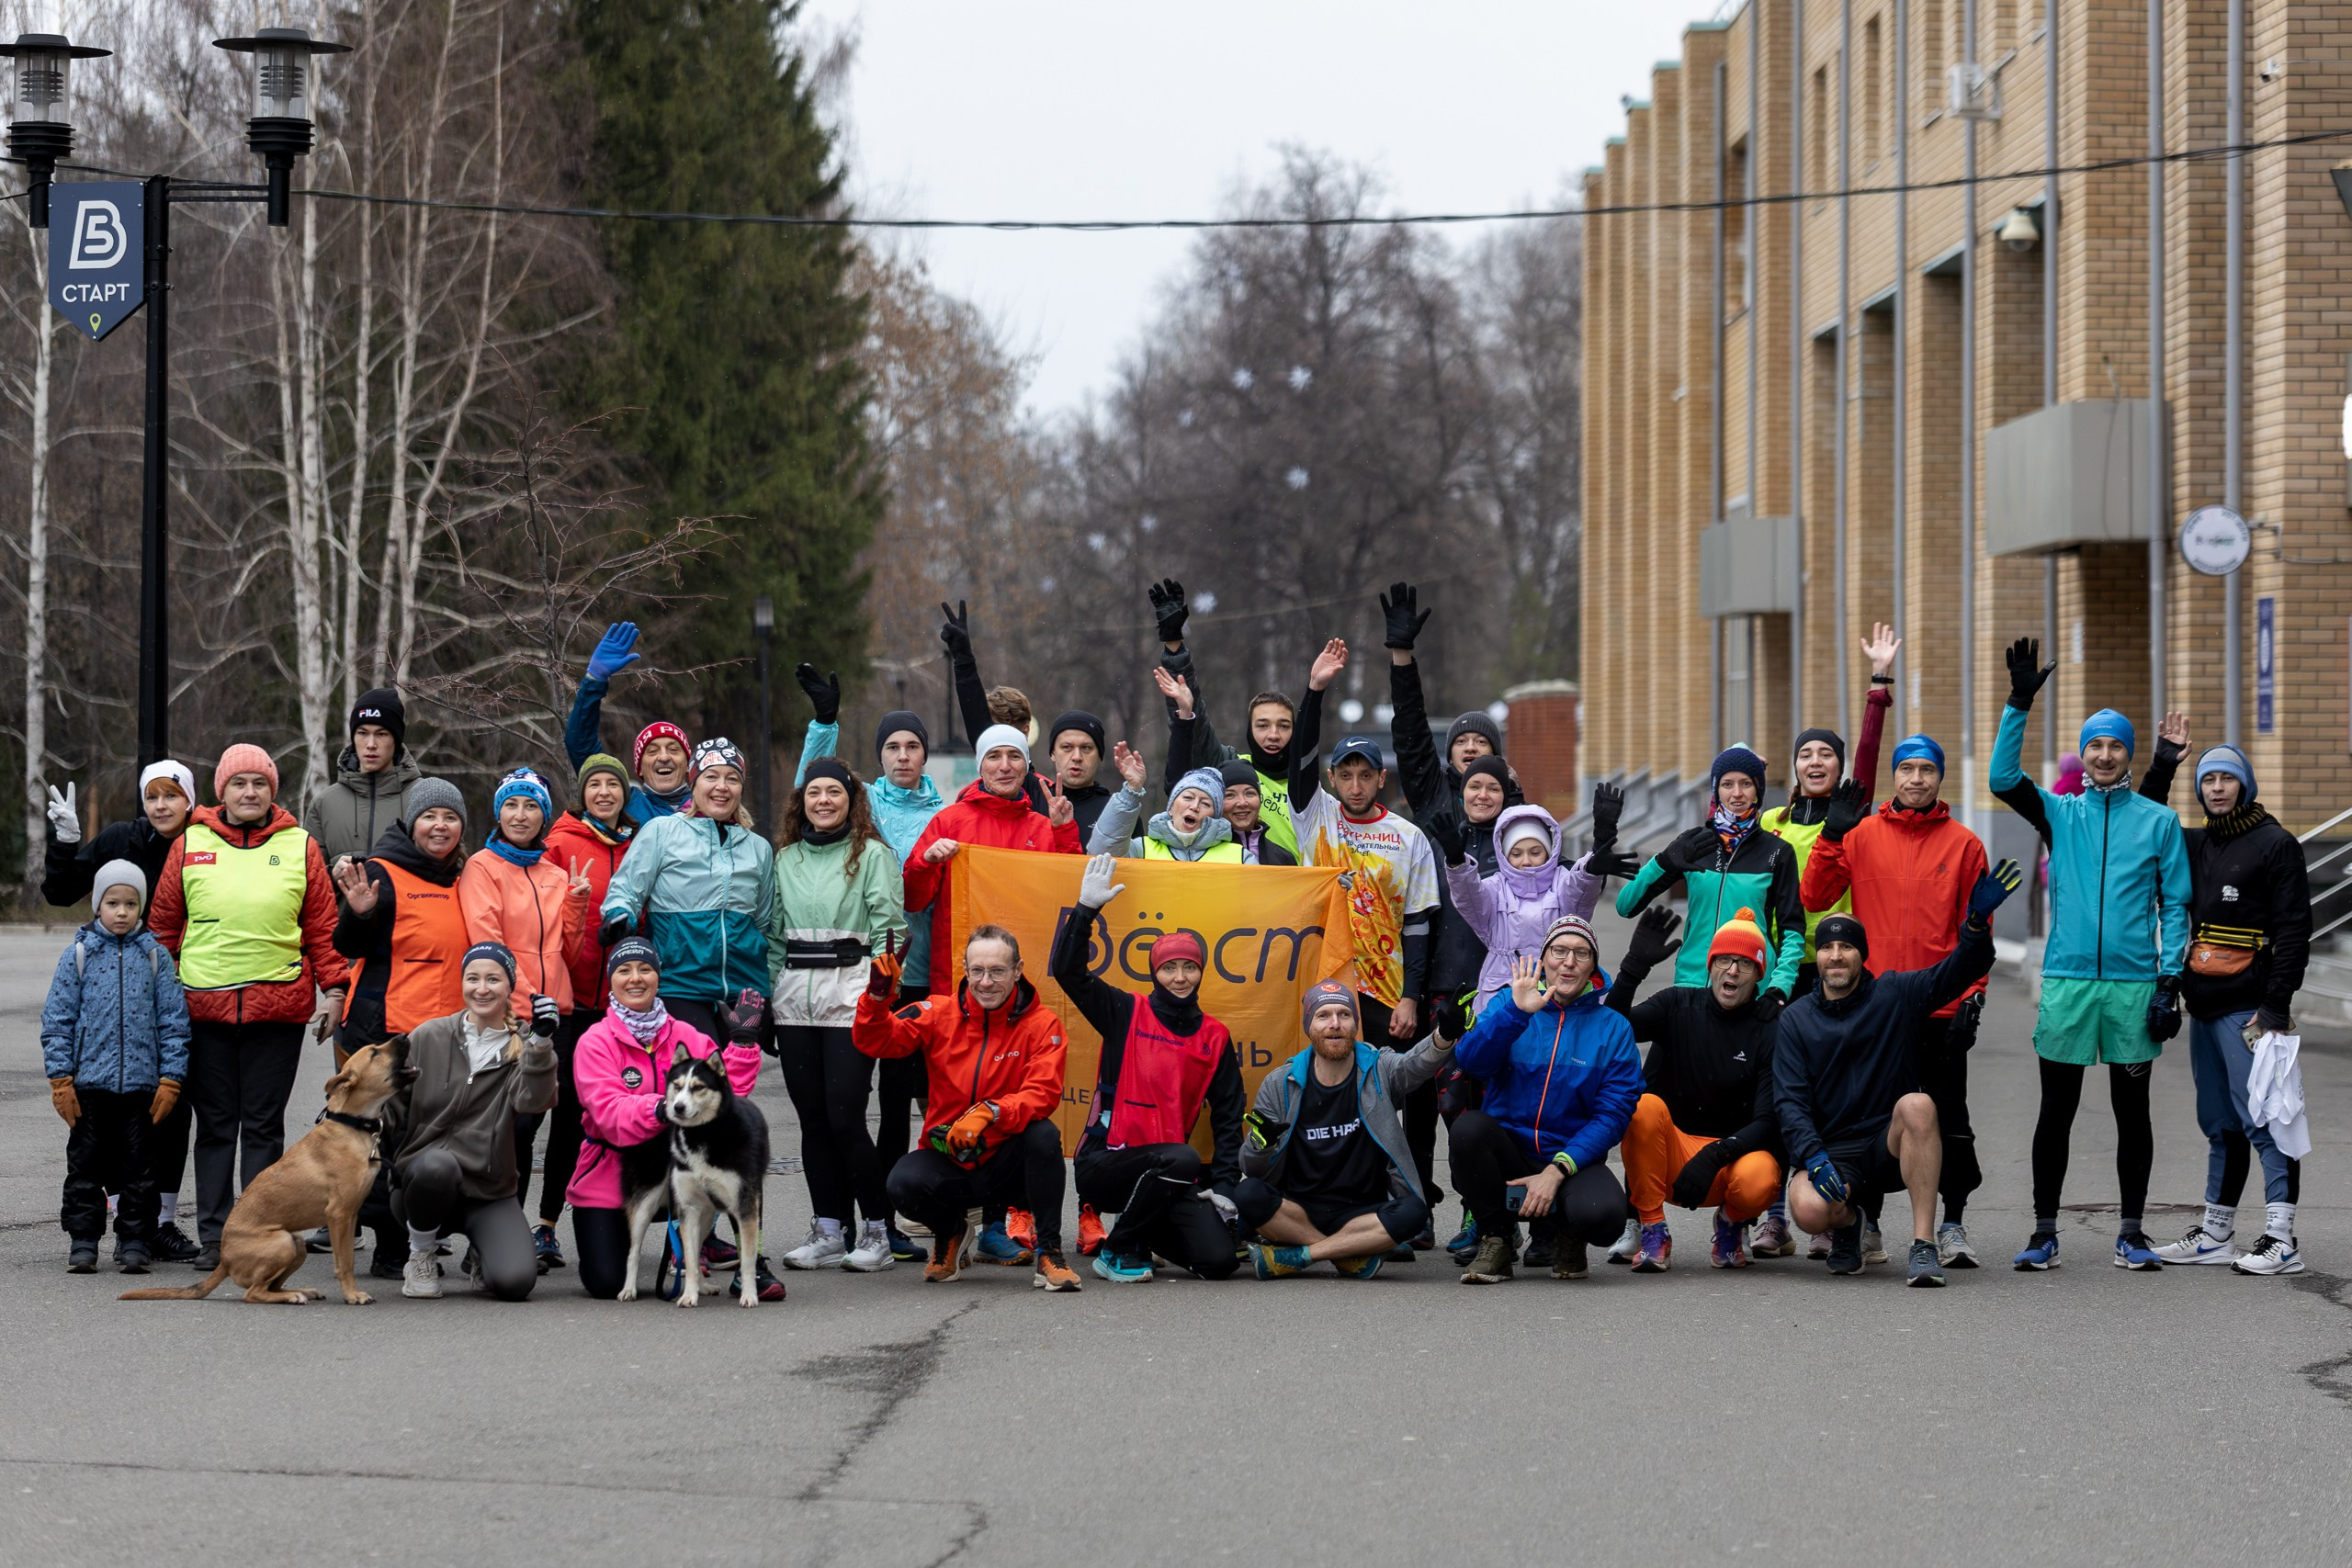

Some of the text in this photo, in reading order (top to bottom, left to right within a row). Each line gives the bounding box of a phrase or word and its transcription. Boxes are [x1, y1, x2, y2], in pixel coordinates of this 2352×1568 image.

[62, 283, 130, 303] СТАРТ
[358, 708, 382, 718] FILA
[1306, 1117, 1361, 1140] DIE HAR
